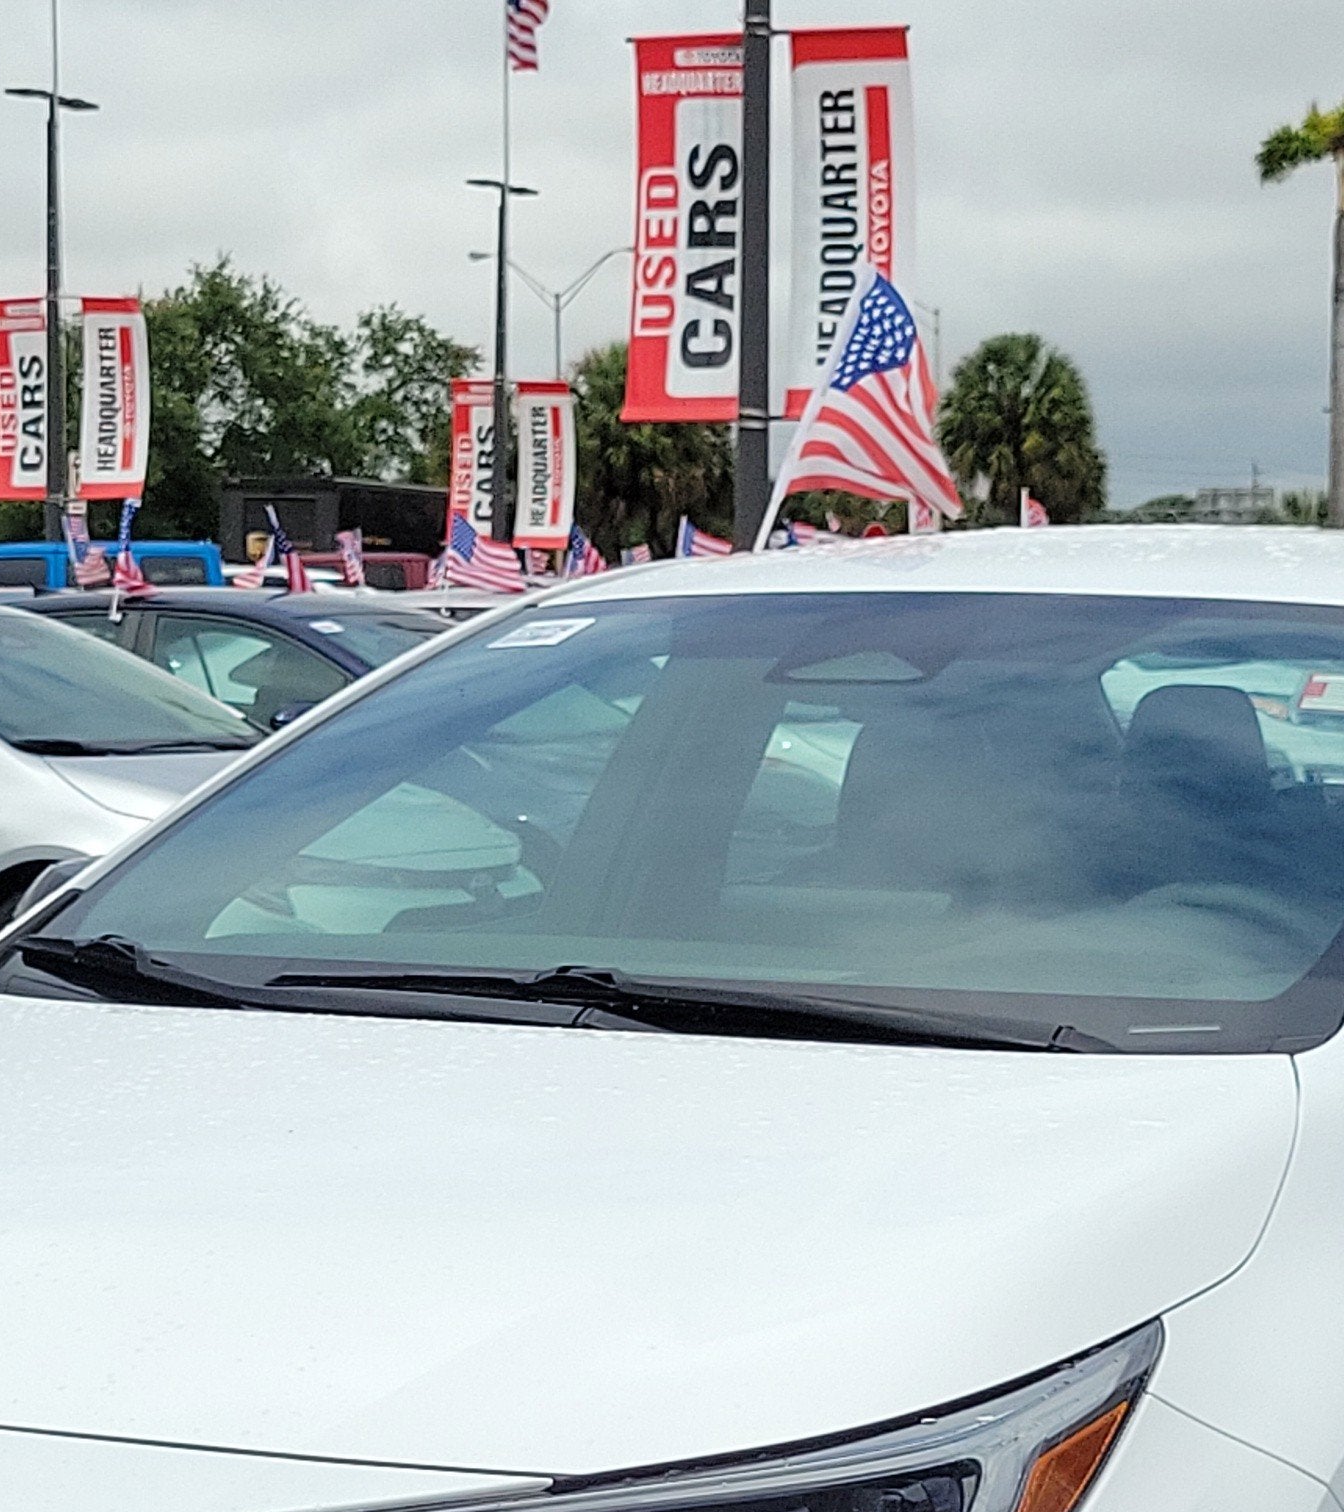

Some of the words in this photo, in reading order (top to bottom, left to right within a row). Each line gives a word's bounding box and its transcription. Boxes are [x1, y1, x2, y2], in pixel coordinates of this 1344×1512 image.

[640, 173, 679, 331] USED
[681, 143, 739, 369] CARS
[868, 158, 891, 267] TOYOTA
[0, 371, 18, 453] USED
[19, 354, 44, 472] CARS
[97, 327, 122, 471] HEADQUARTER
[458, 438, 473, 505] USED
[475, 425, 495, 522] CARS
[530, 406, 551, 527] HEADQUARTER
